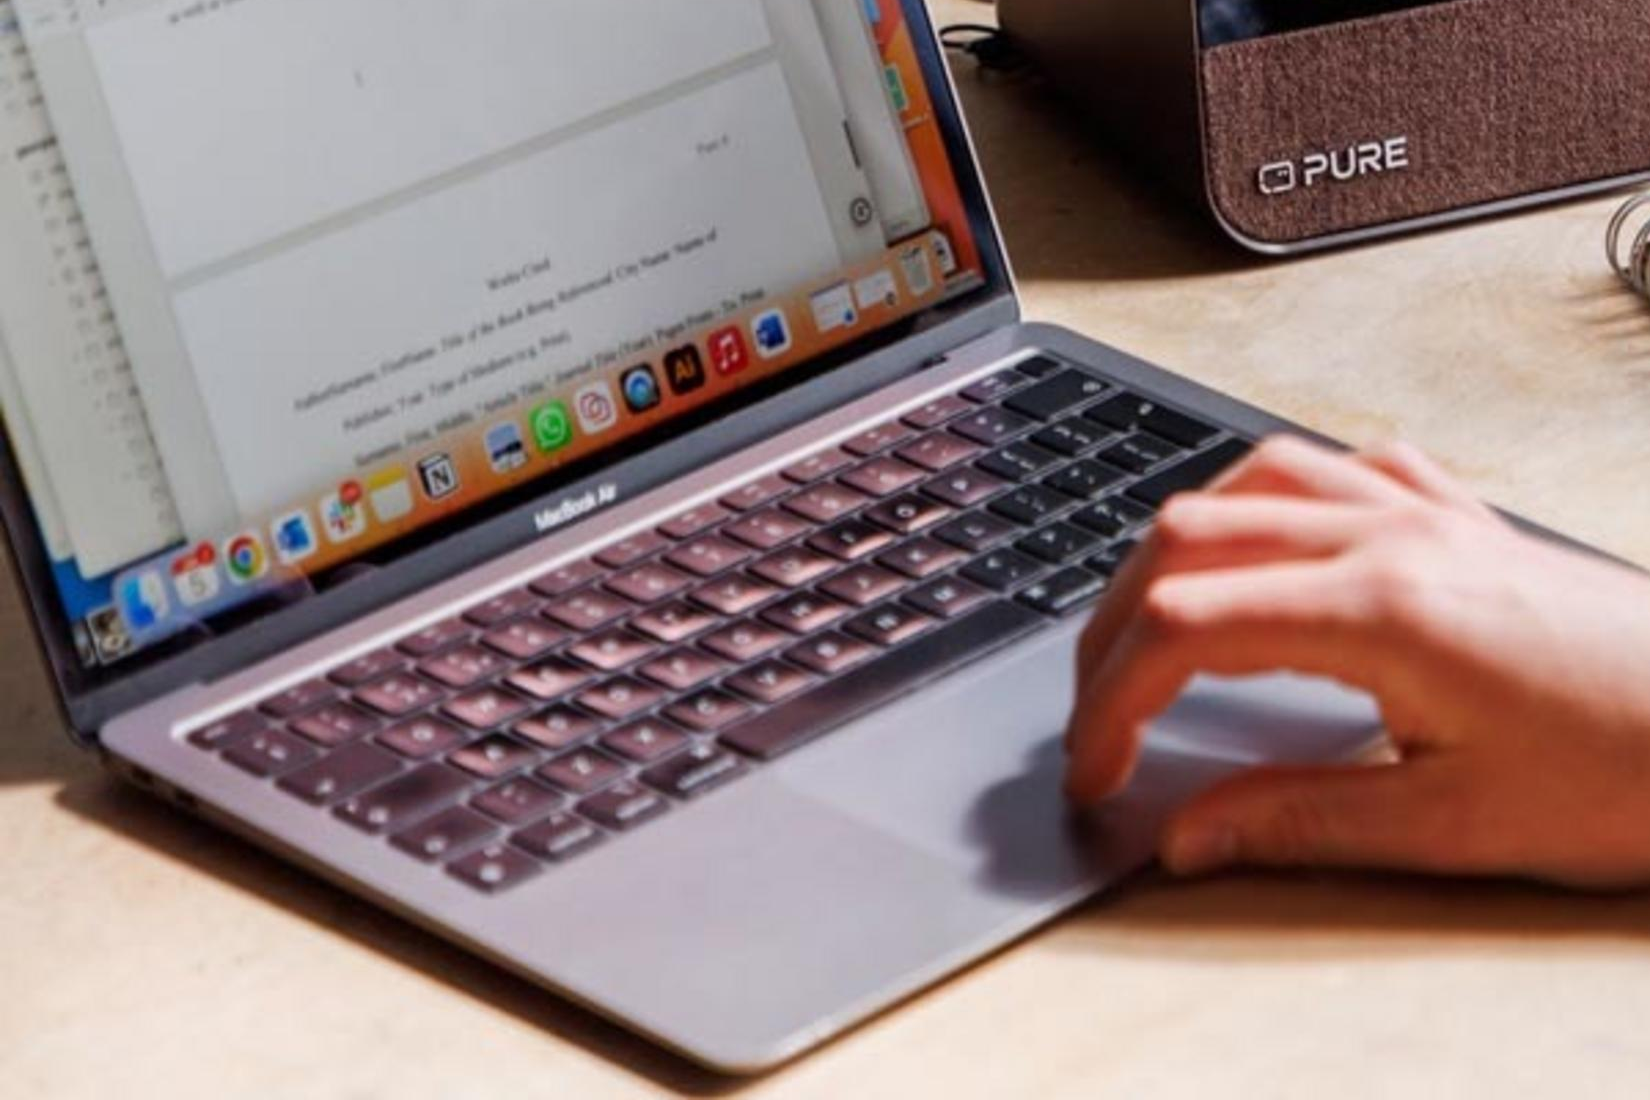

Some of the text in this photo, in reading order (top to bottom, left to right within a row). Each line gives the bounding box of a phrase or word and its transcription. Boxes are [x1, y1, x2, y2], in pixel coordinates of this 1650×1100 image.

[1303, 137, 1409, 186] PURE
[674, 353, 697, 384] Ai
[430, 464, 450, 490] N
[533, 483, 617, 533] MacBook Air
